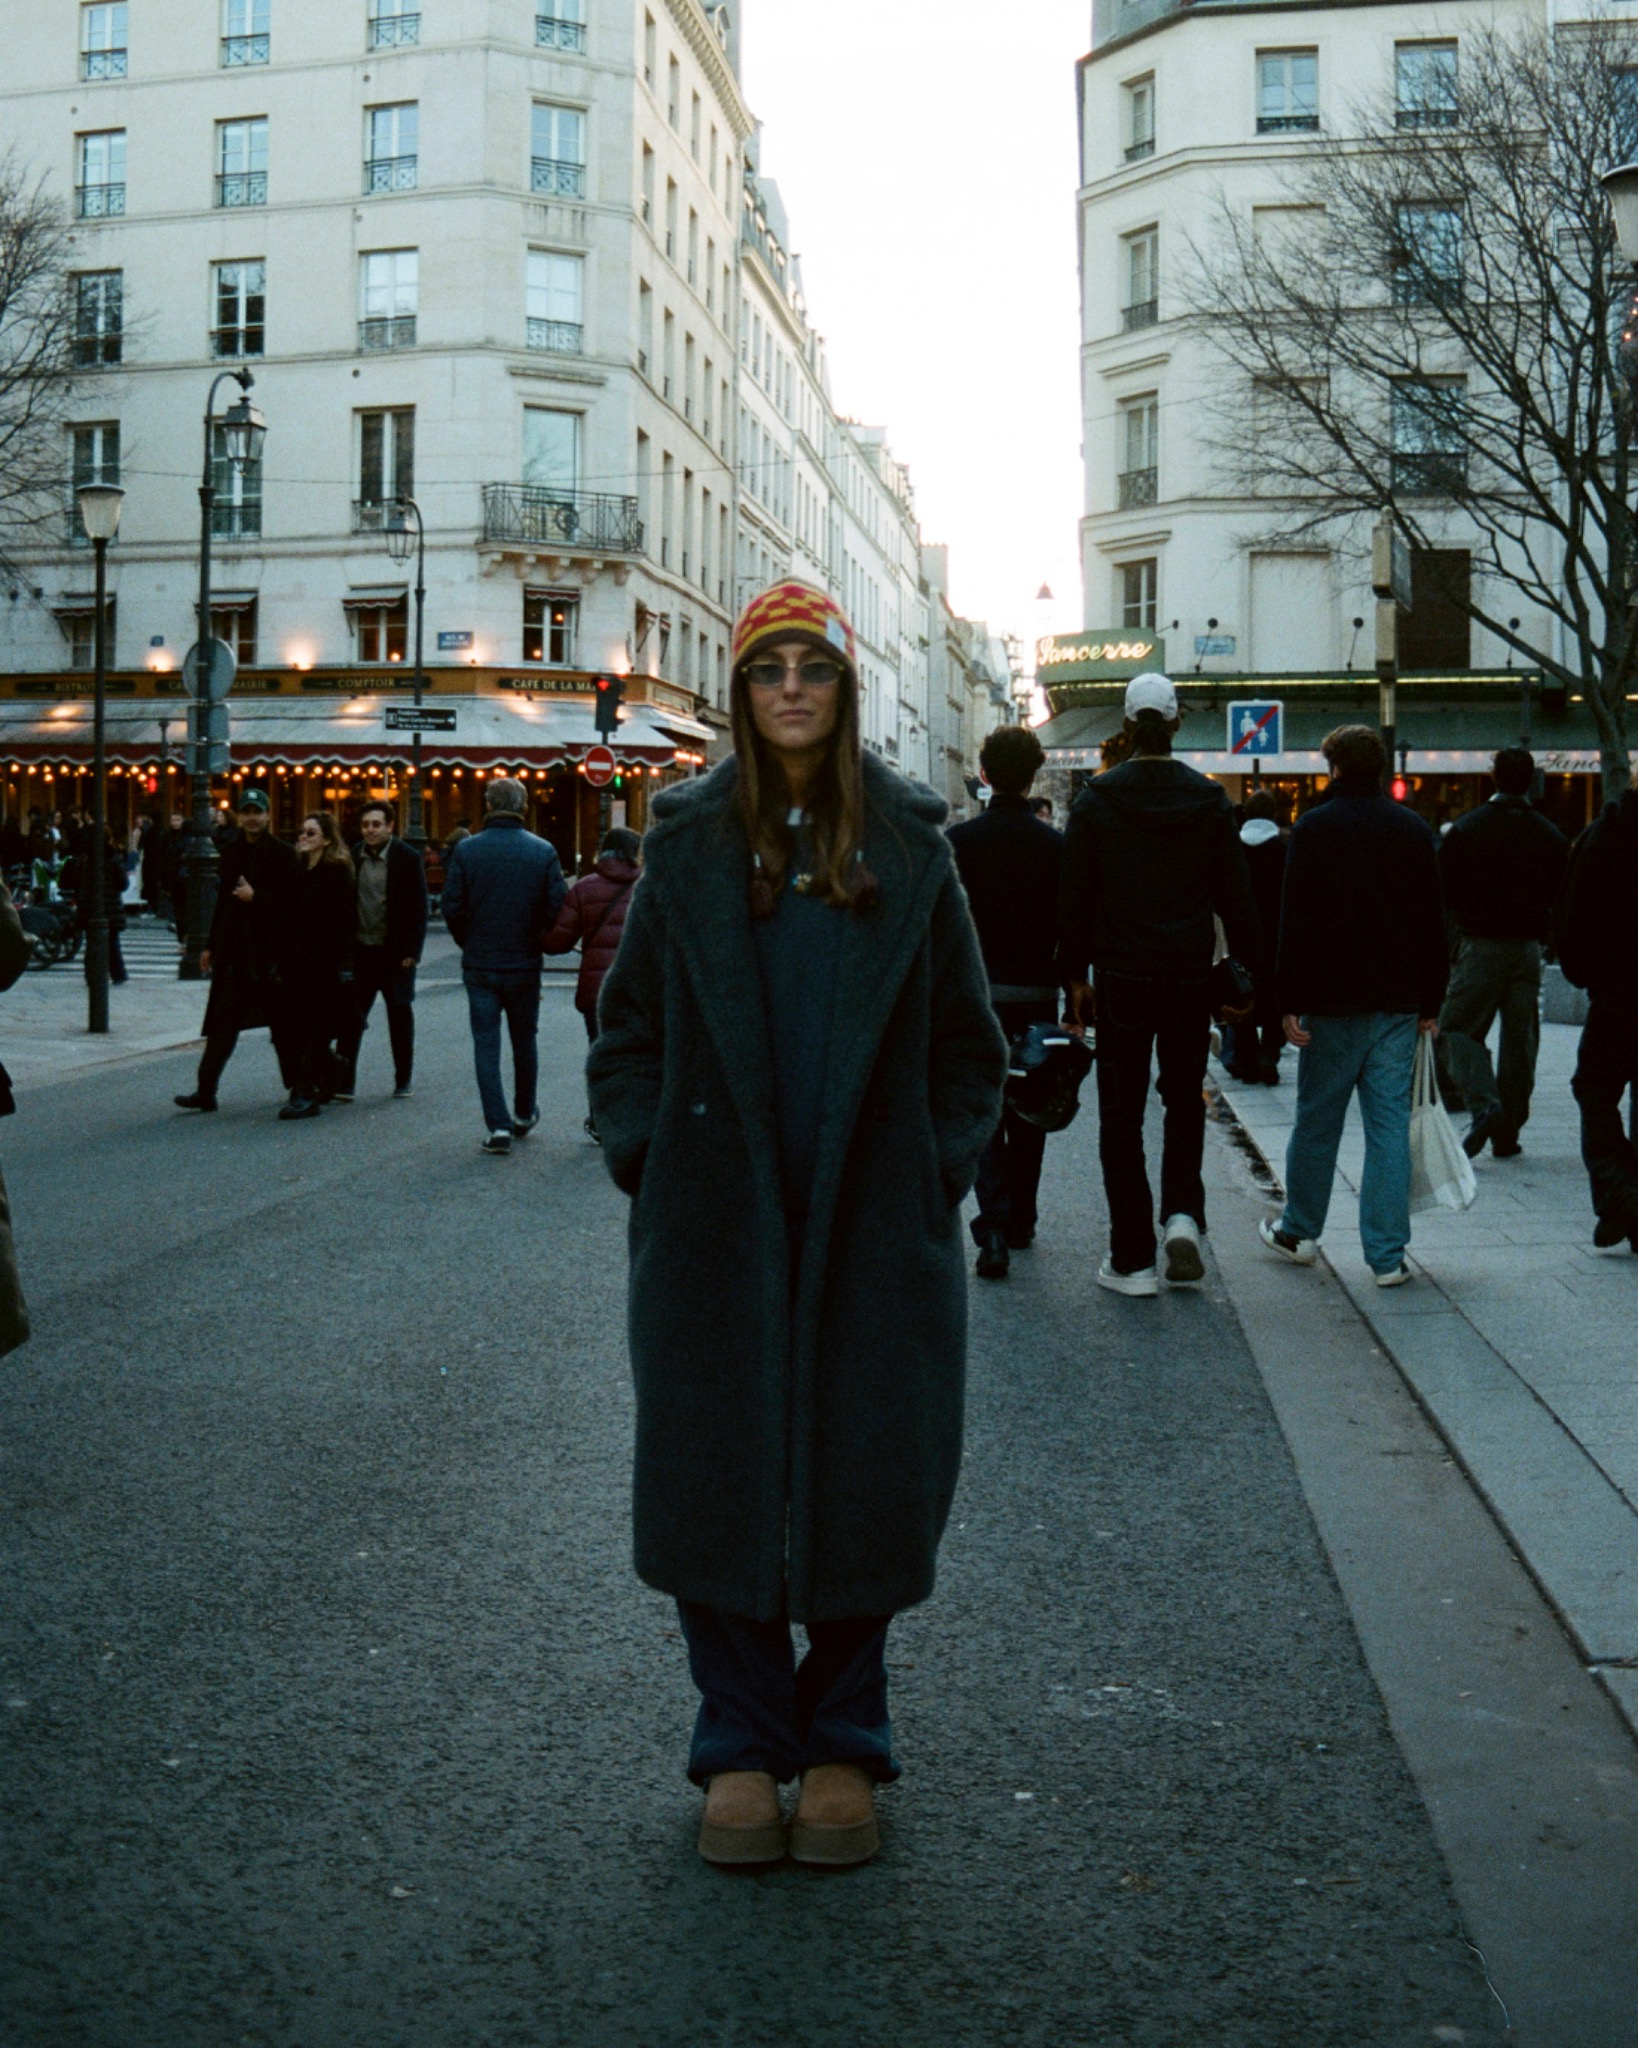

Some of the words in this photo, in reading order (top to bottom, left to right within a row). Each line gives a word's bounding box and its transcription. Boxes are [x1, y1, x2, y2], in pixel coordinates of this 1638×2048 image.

[1038, 636, 1154, 666] Sancerre
[55, 682, 96, 692] BISTROT
[338, 678, 395, 688] COMPTOIR
[543, 681, 555, 690] DE
[561, 681, 574, 691] LA
